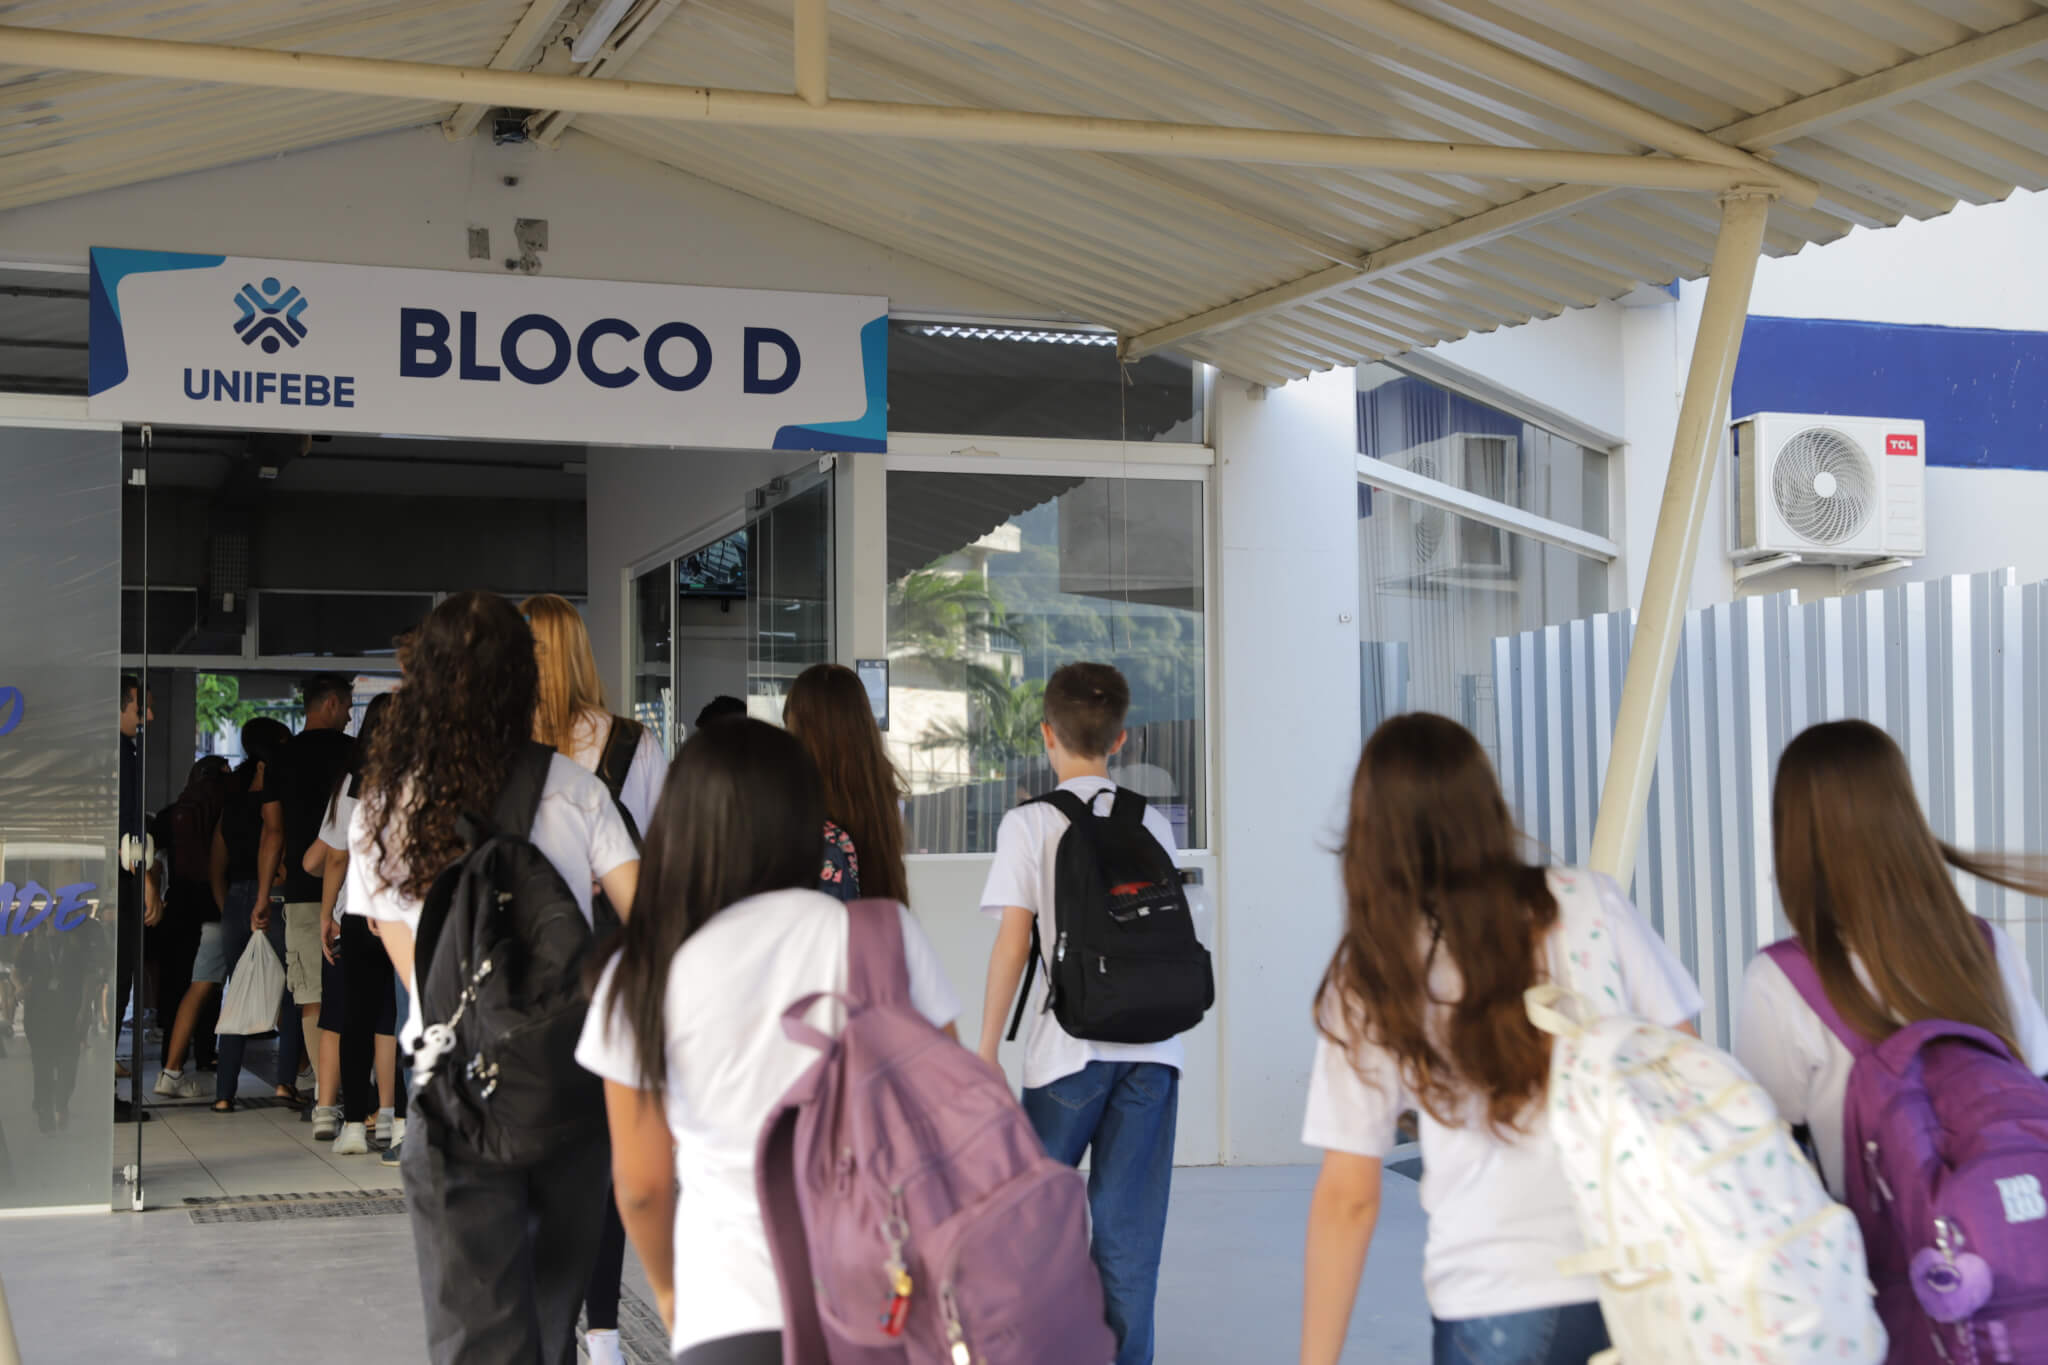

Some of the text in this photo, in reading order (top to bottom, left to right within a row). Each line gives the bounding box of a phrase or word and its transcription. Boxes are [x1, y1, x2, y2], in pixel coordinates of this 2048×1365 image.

[400, 307, 802, 395] BLOCO D
[183, 367, 355, 408] UNIFEBE
[1889, 439, 1913, 450] TCL
